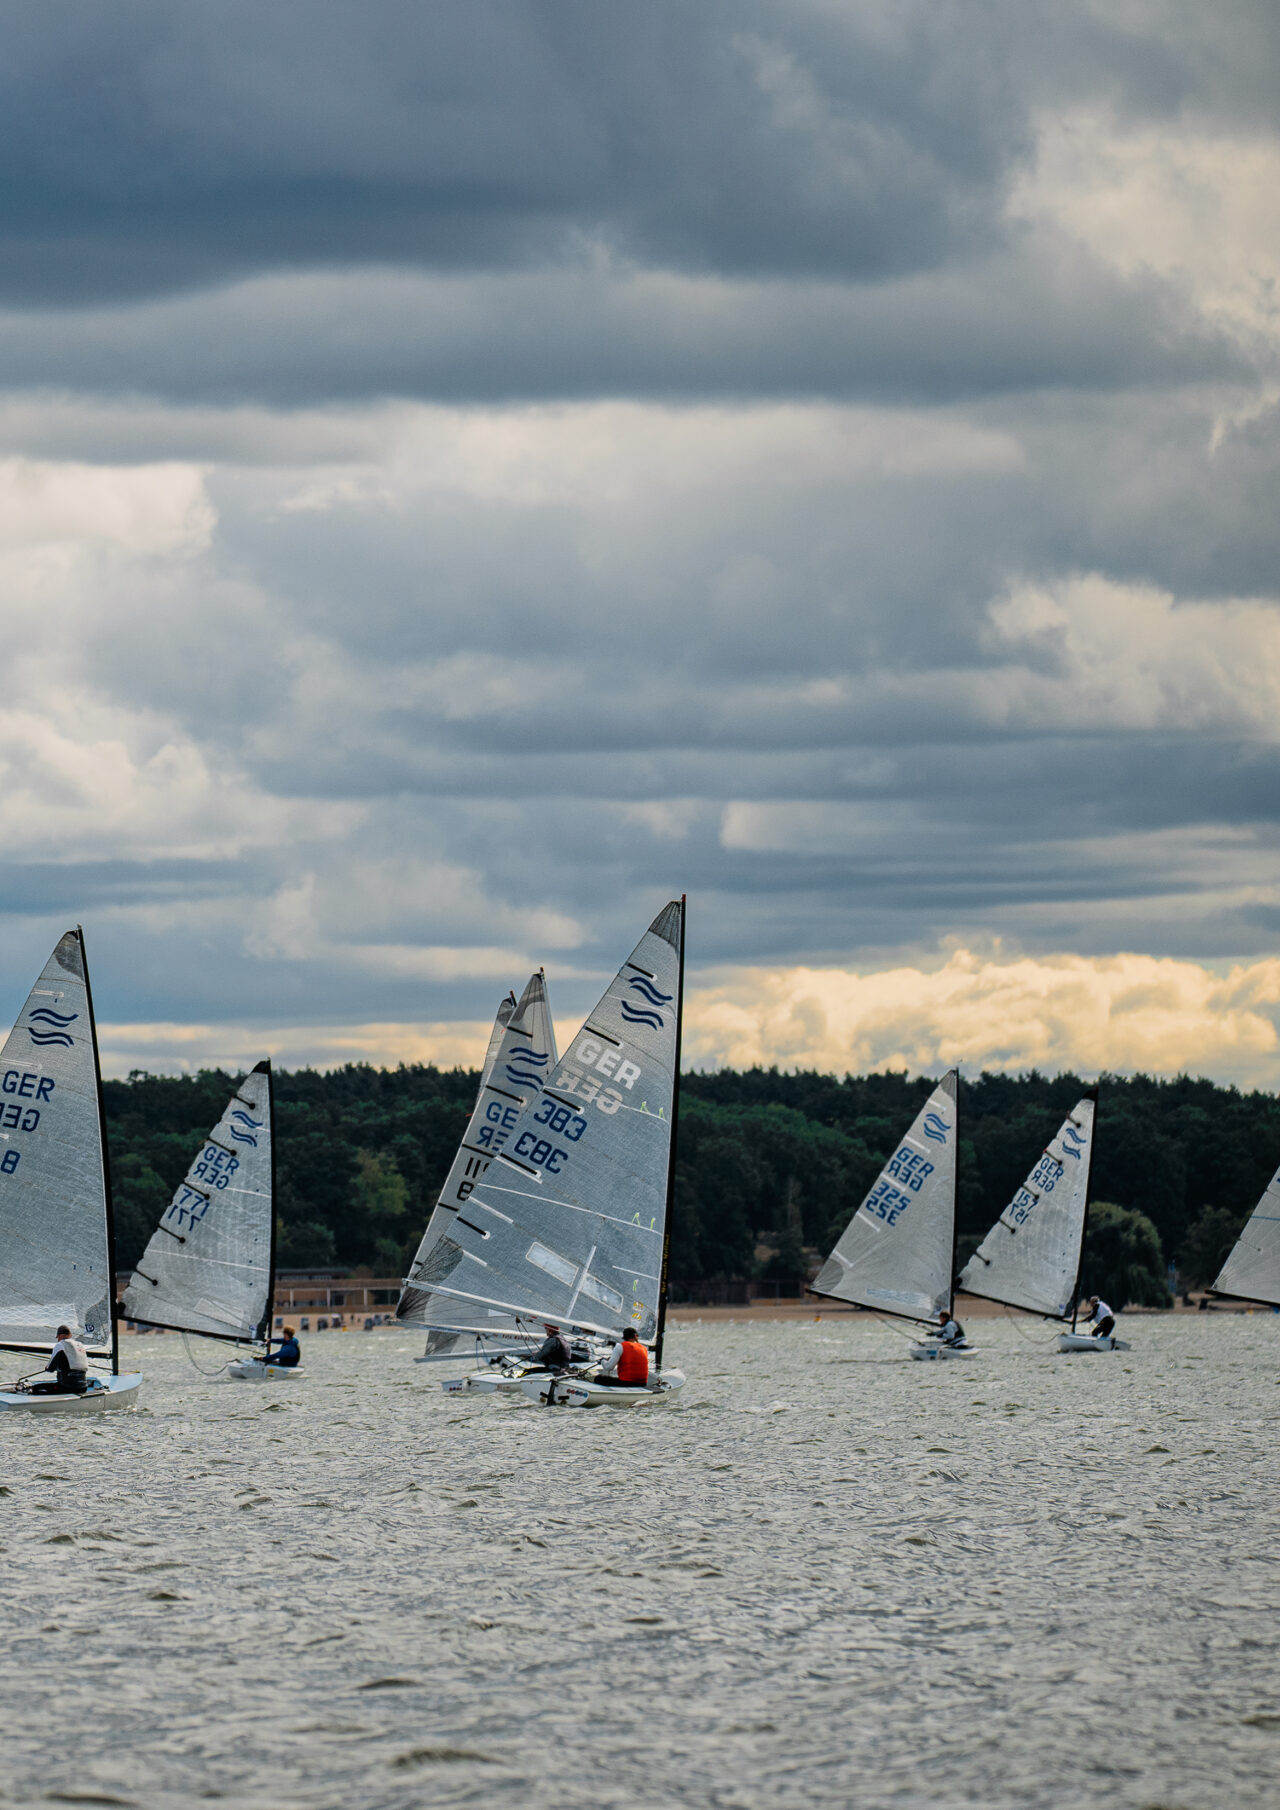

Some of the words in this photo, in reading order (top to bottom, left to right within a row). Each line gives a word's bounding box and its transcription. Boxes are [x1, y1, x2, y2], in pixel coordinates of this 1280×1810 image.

[575, 1037, 642, 1091] GER
[2, 1069, 55, 1104] GER
[533, 1099, 588, 1142] 383
[204, 1145, 240, 1176] GER
[464, 1157, 490, 1179] 11
[896, 1146, 935, 1178] GER
[1039, 1157, 1064, 1181] GER
[178, 1187, 210, 1218] 771
[872, 1181, 911, 1212] 325
[1017, 1191, 1038, 1214] 157
